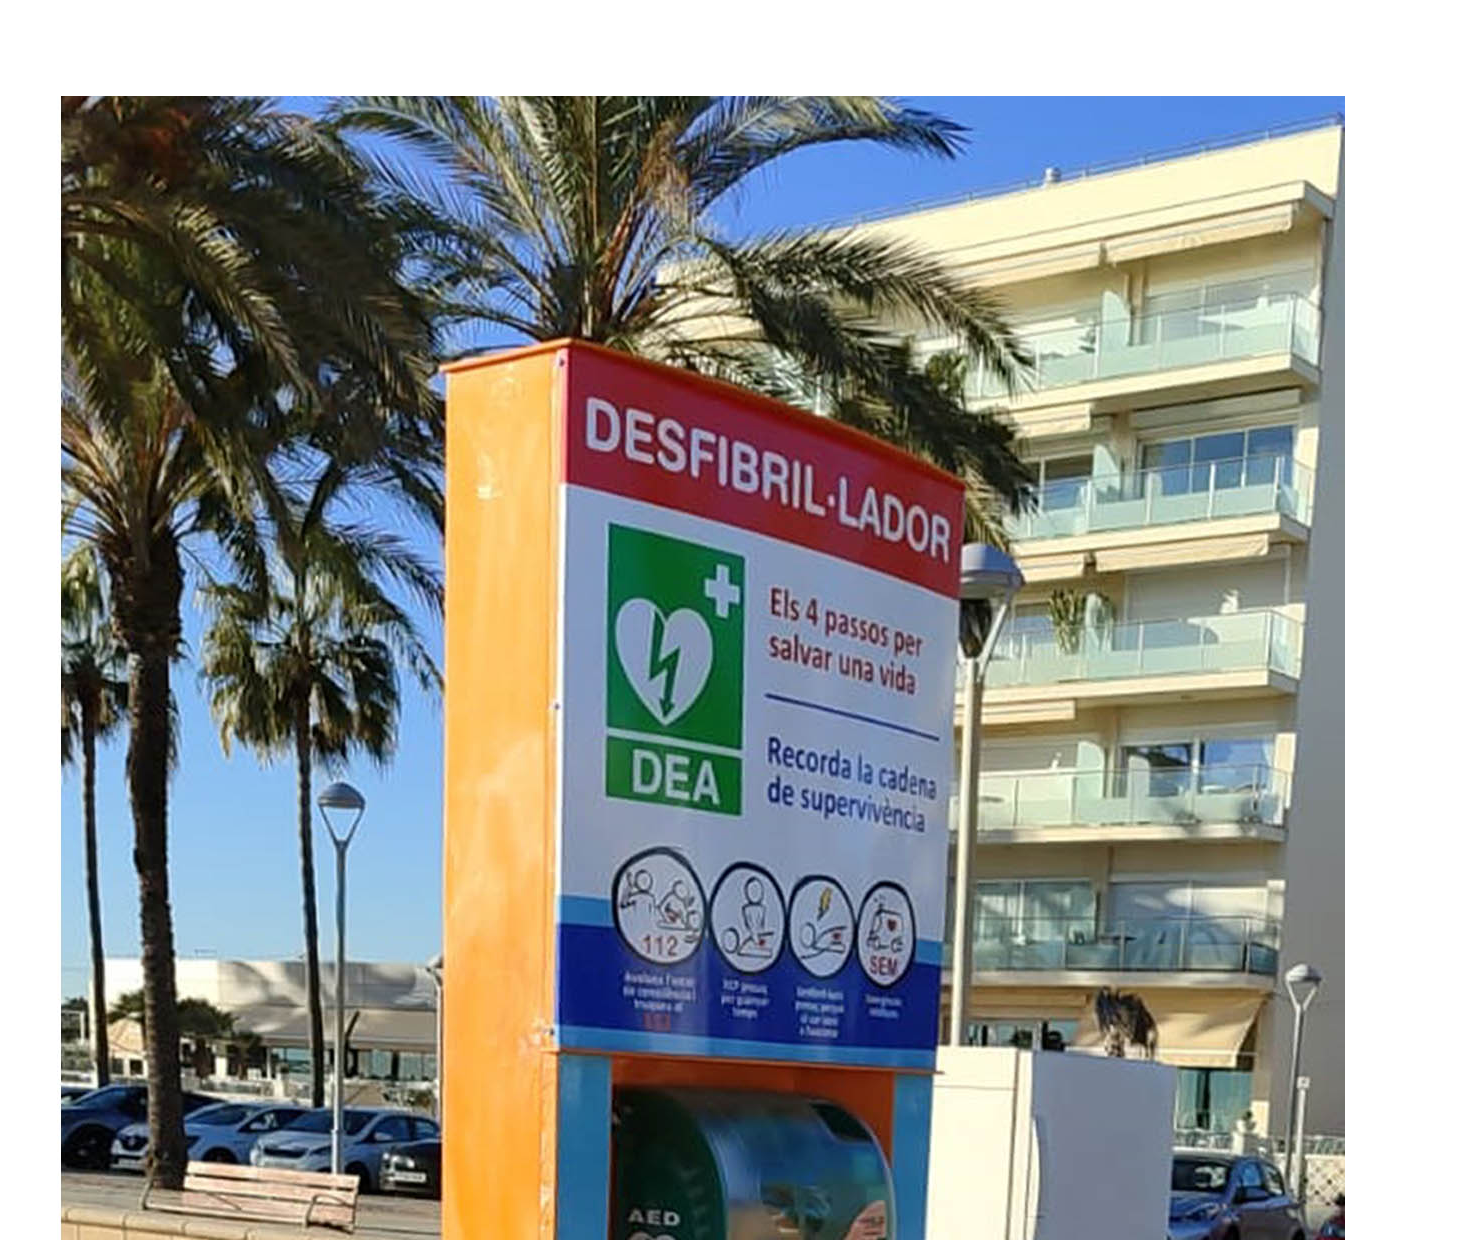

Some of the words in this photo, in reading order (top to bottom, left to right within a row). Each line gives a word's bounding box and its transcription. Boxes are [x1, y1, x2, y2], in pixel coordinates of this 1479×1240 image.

[770, 587, 800, 622] Els
[806, 598, 819, 626] 4
[825, 608, 888, 646] passos
[894, 631, 923, 658] per
[769, 633, 831, 669] salvar
[839, 658, 874, 683] una
[879, 665, 916, 695] vida
[632, 749, 720, 806] DEA
[768, 736, 851, 780] Recorda
[857, 758, 874, 785] la
[879, 764, 937, 801] cadena
[768, 777, 794, 807] de
[800, 787, 926, 833] supervivència
[642, 934, 678, 957] 112
[628, 1209, 681, 1227] AED
